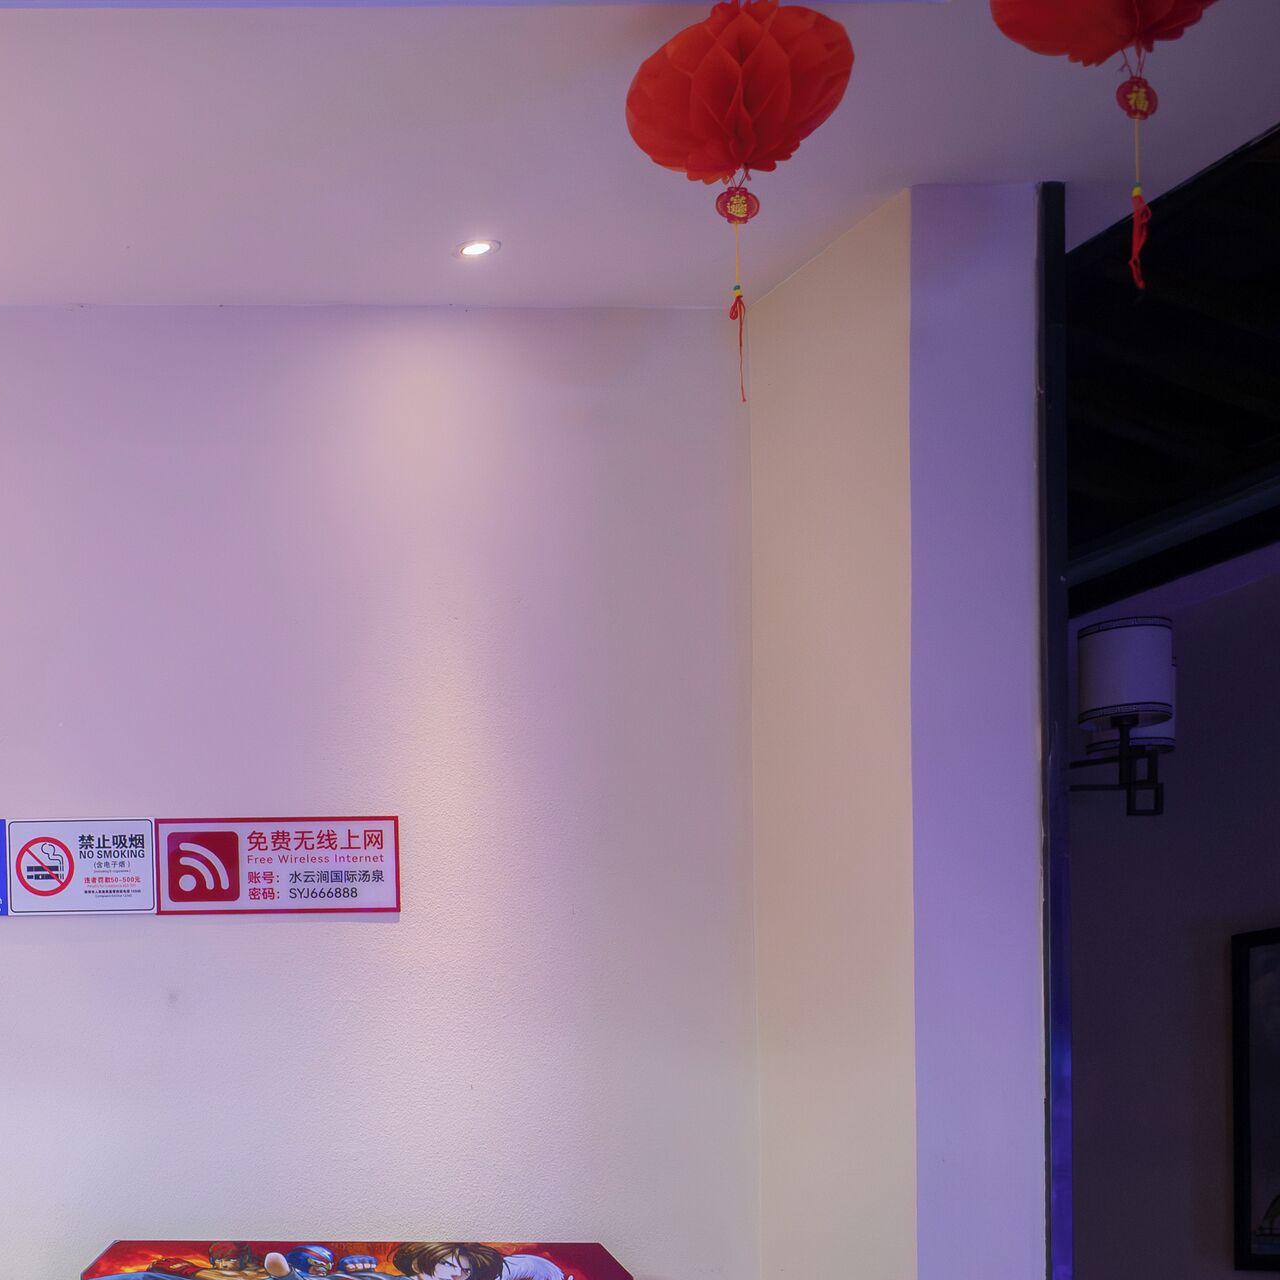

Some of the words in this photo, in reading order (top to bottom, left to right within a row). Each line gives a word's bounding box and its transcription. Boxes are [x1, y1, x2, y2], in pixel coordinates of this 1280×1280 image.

[78, 834, 145, 849] 禁止吸烟
[247, 829, 384, 851] 免费无线上网
[79, 850, 94, 859] NO
[96, 849, 145, 859] SMOKING
[247, 855, 273, 864] Free
[278, 854, 330, 864] Wireless
[334, 854, 384, 863] Internet
[289, 869, 385, 884] 水云涧国际汤泉
[289, 888, 358, 900] SYJ666888
